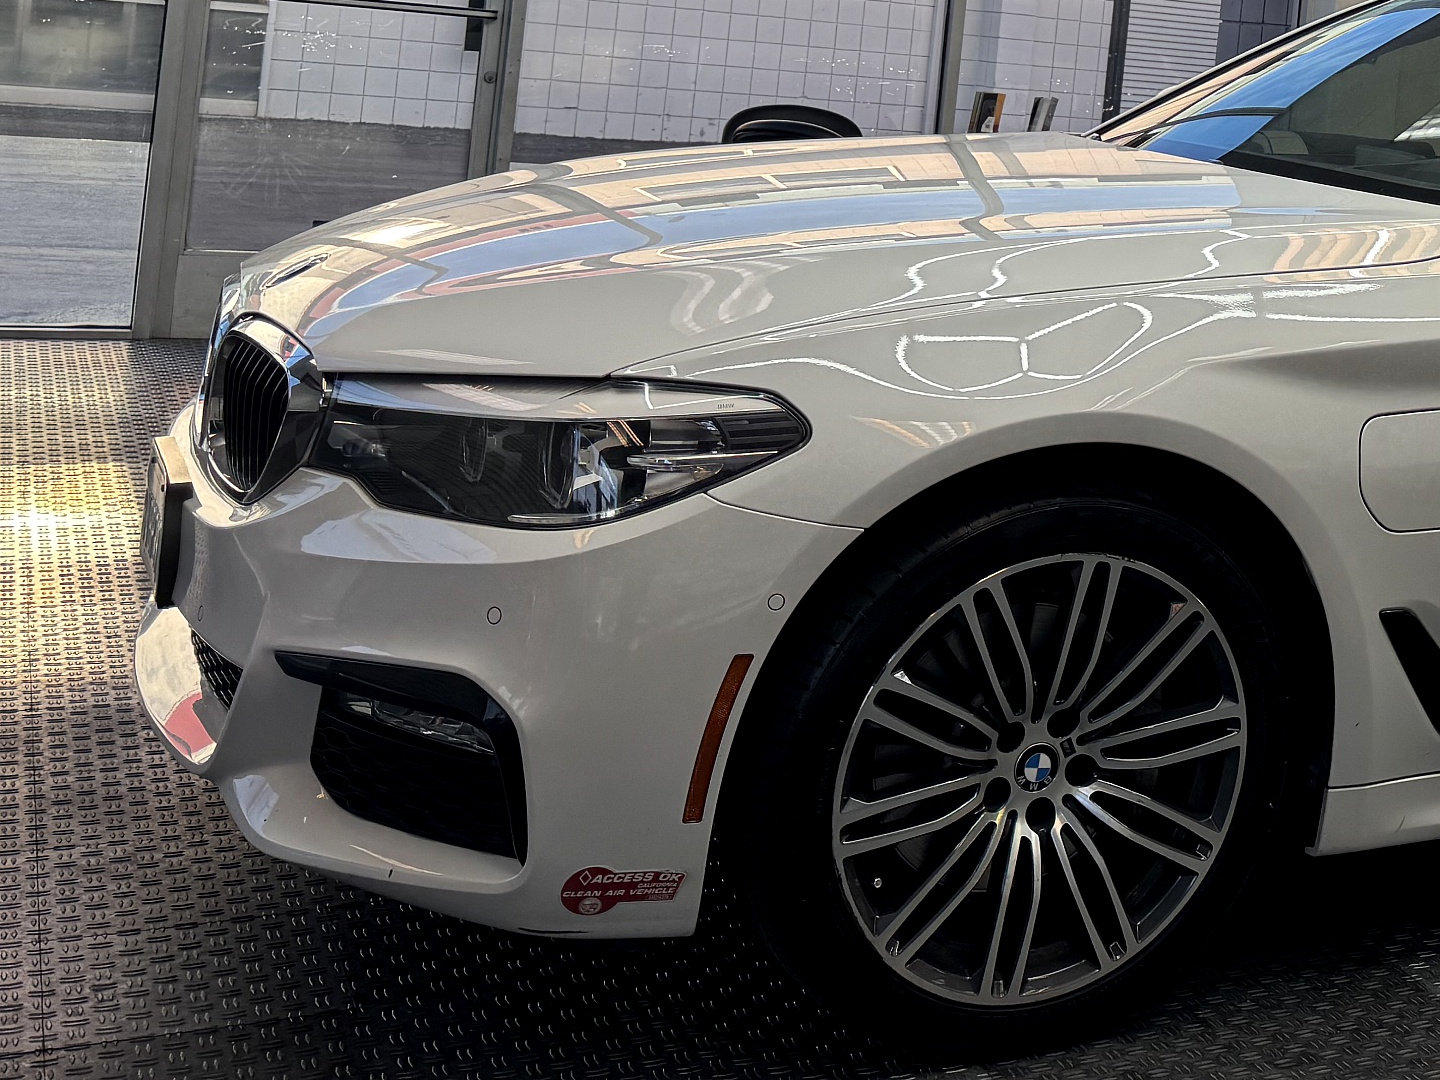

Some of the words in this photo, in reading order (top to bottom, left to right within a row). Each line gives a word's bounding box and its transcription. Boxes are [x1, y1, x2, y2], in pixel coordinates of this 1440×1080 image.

[590, 872, 655, 884] ACCESS
[659, 872, 682, 882] OK
[637, 881, 678, 889] CALIFORNIA
[562, 890, 602, 898] CLEAN
[629, 886, 676, 896] VEHICLE
